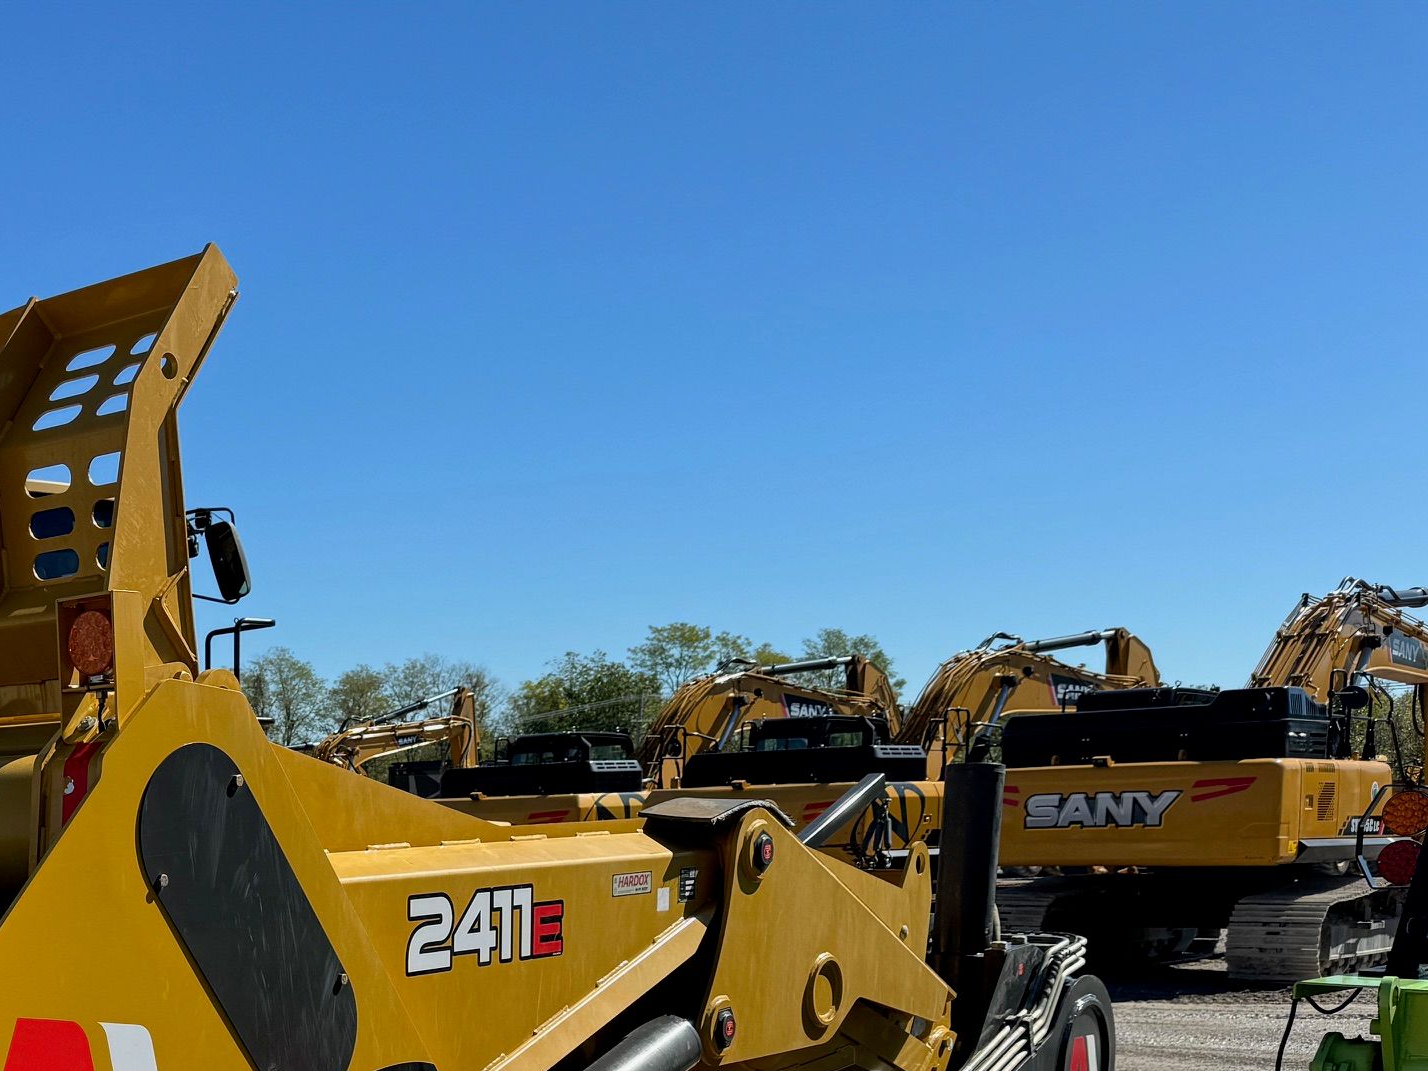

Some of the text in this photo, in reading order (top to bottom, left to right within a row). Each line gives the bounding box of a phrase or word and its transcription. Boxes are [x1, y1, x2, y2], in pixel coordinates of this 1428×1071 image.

[1392, 638, 1420, 662] SANY
[790, 702, 827, 718] SANY
[1024, 790, 1184, 829] SANY
[618, 874, 649, 888] HARDOX
[406, 883, 563, 977] 2411E
